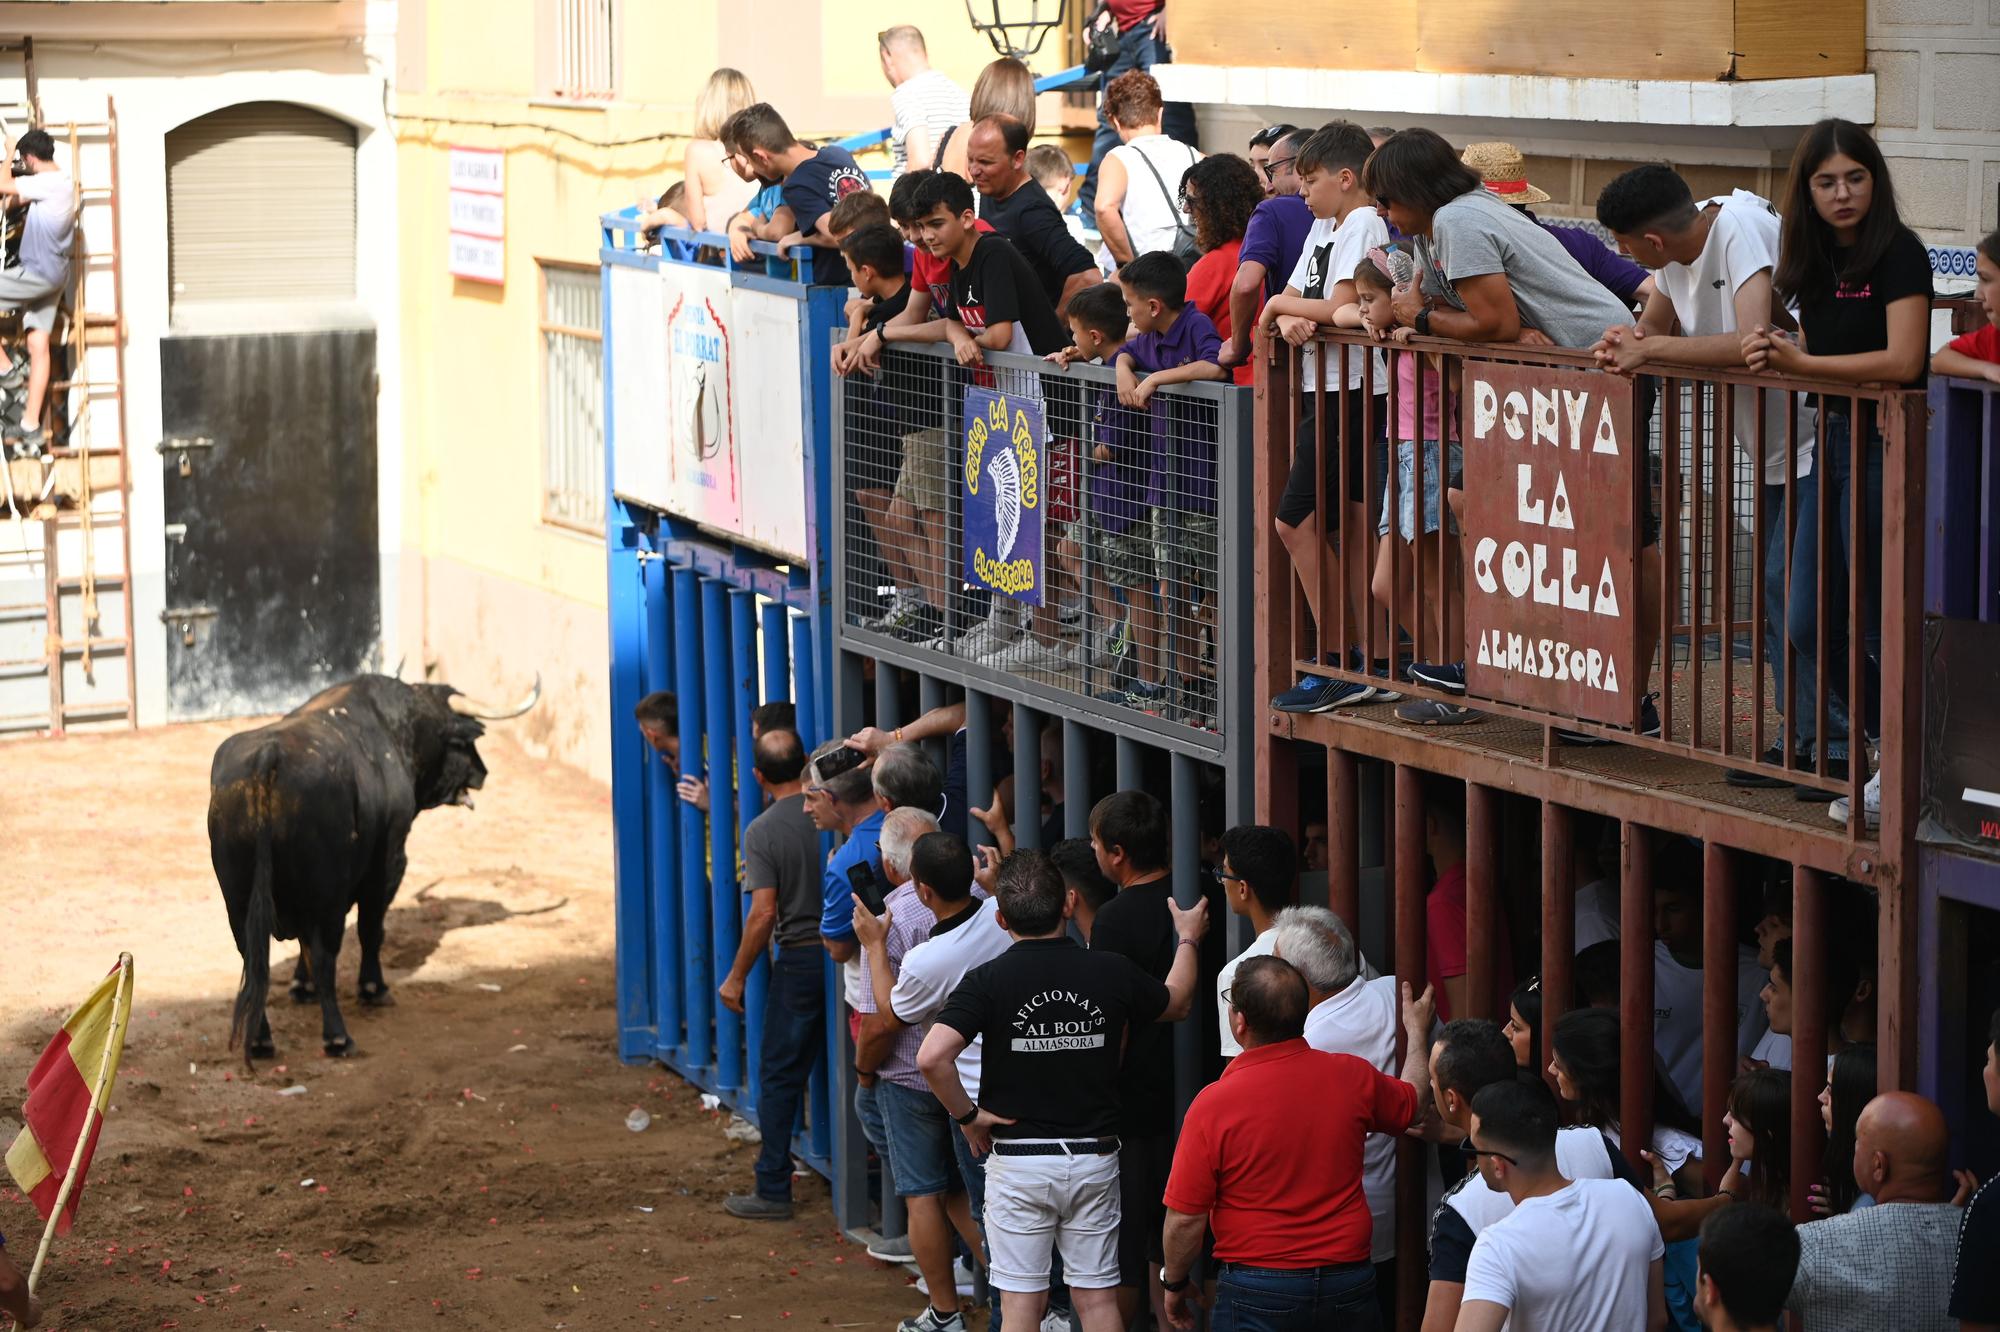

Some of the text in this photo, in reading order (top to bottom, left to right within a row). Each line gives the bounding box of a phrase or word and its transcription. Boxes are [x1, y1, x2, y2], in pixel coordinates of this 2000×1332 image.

[966, 417, 987, 495] COLLA
[989, 396, 1009, 432] LA
[1518, 464, 1575, 529] LA
[974, 547, 1034, 596] ALMASSORA
[1474, 537, 1620, 617] COLLA
[1477, 629, 1619, 693] ALMASSORA
[1012, 989, 1106, 1031] AFICIONATS
[1025, 1020, 1093, 1036] AL BOU
[1023, 1037, 1095, 1051] ALMASSORA
